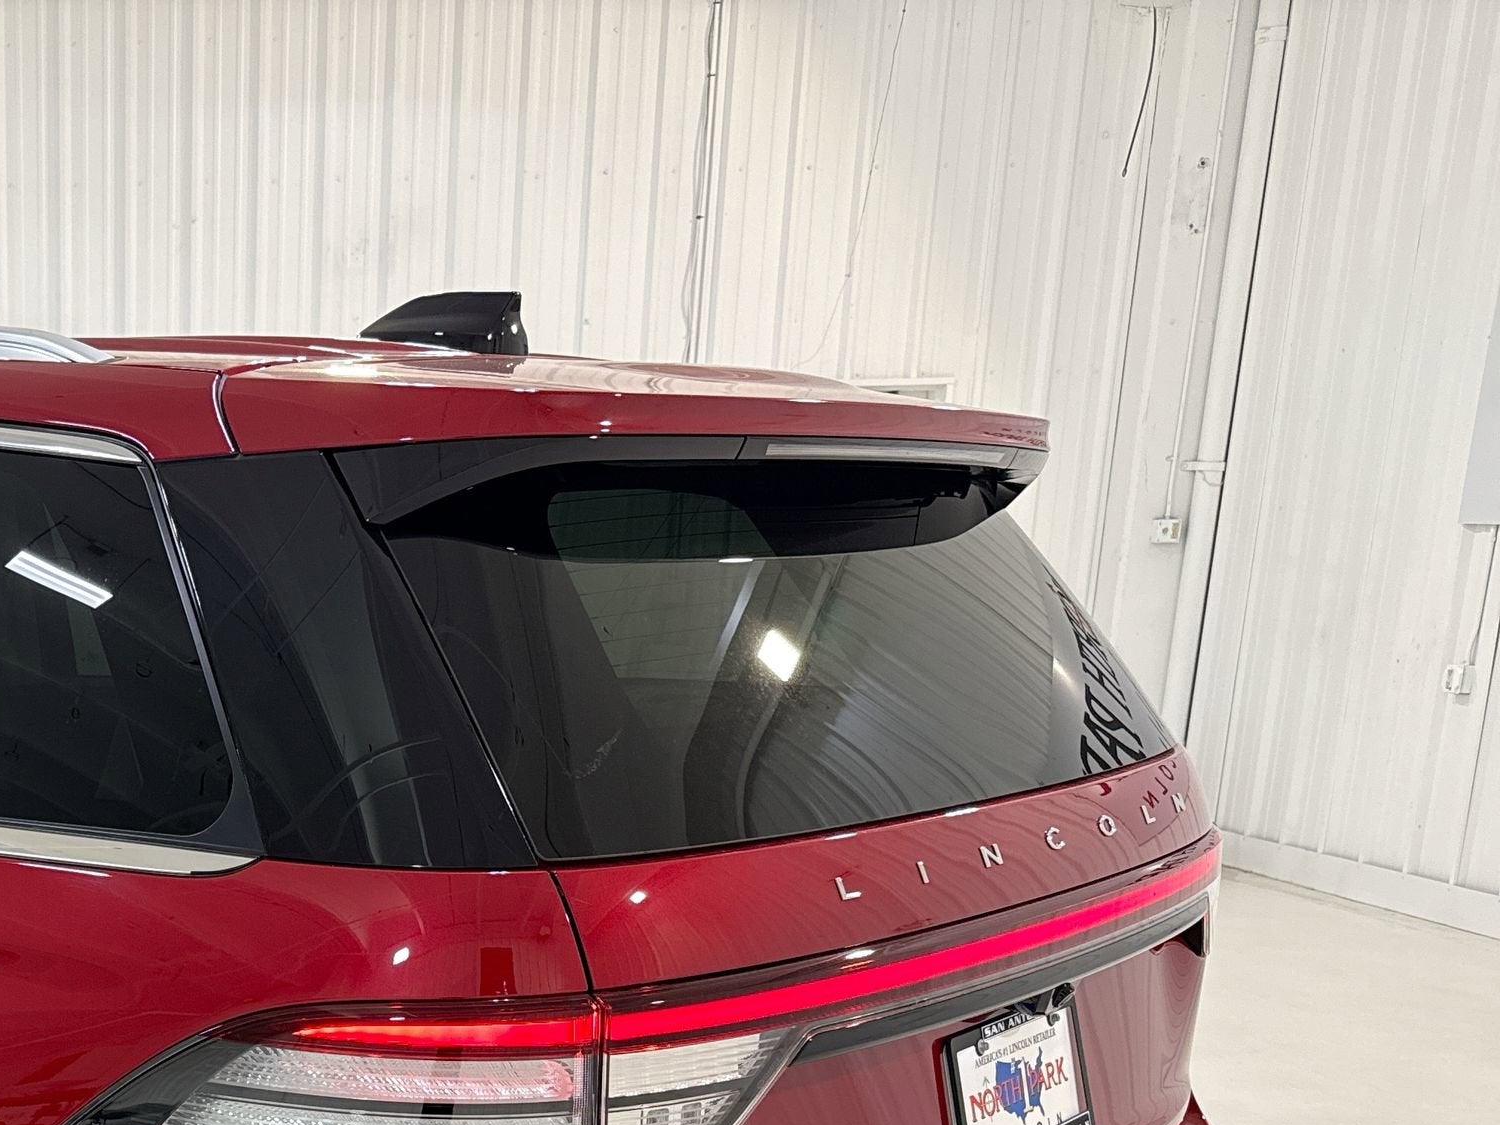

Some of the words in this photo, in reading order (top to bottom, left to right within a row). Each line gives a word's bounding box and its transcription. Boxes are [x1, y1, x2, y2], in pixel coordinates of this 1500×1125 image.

[835, 793, 1186, 901] LINCOLN
[983, 1021, 1005, 1038] SAN
[1009, 1038, 1033, 1054] LINCOLN
[1033, 1027, 1057, 1044] RETAILER
[969, 1076, 1022, 1122] NORTH
[1026, 1057, 1068, 1096] PARK
